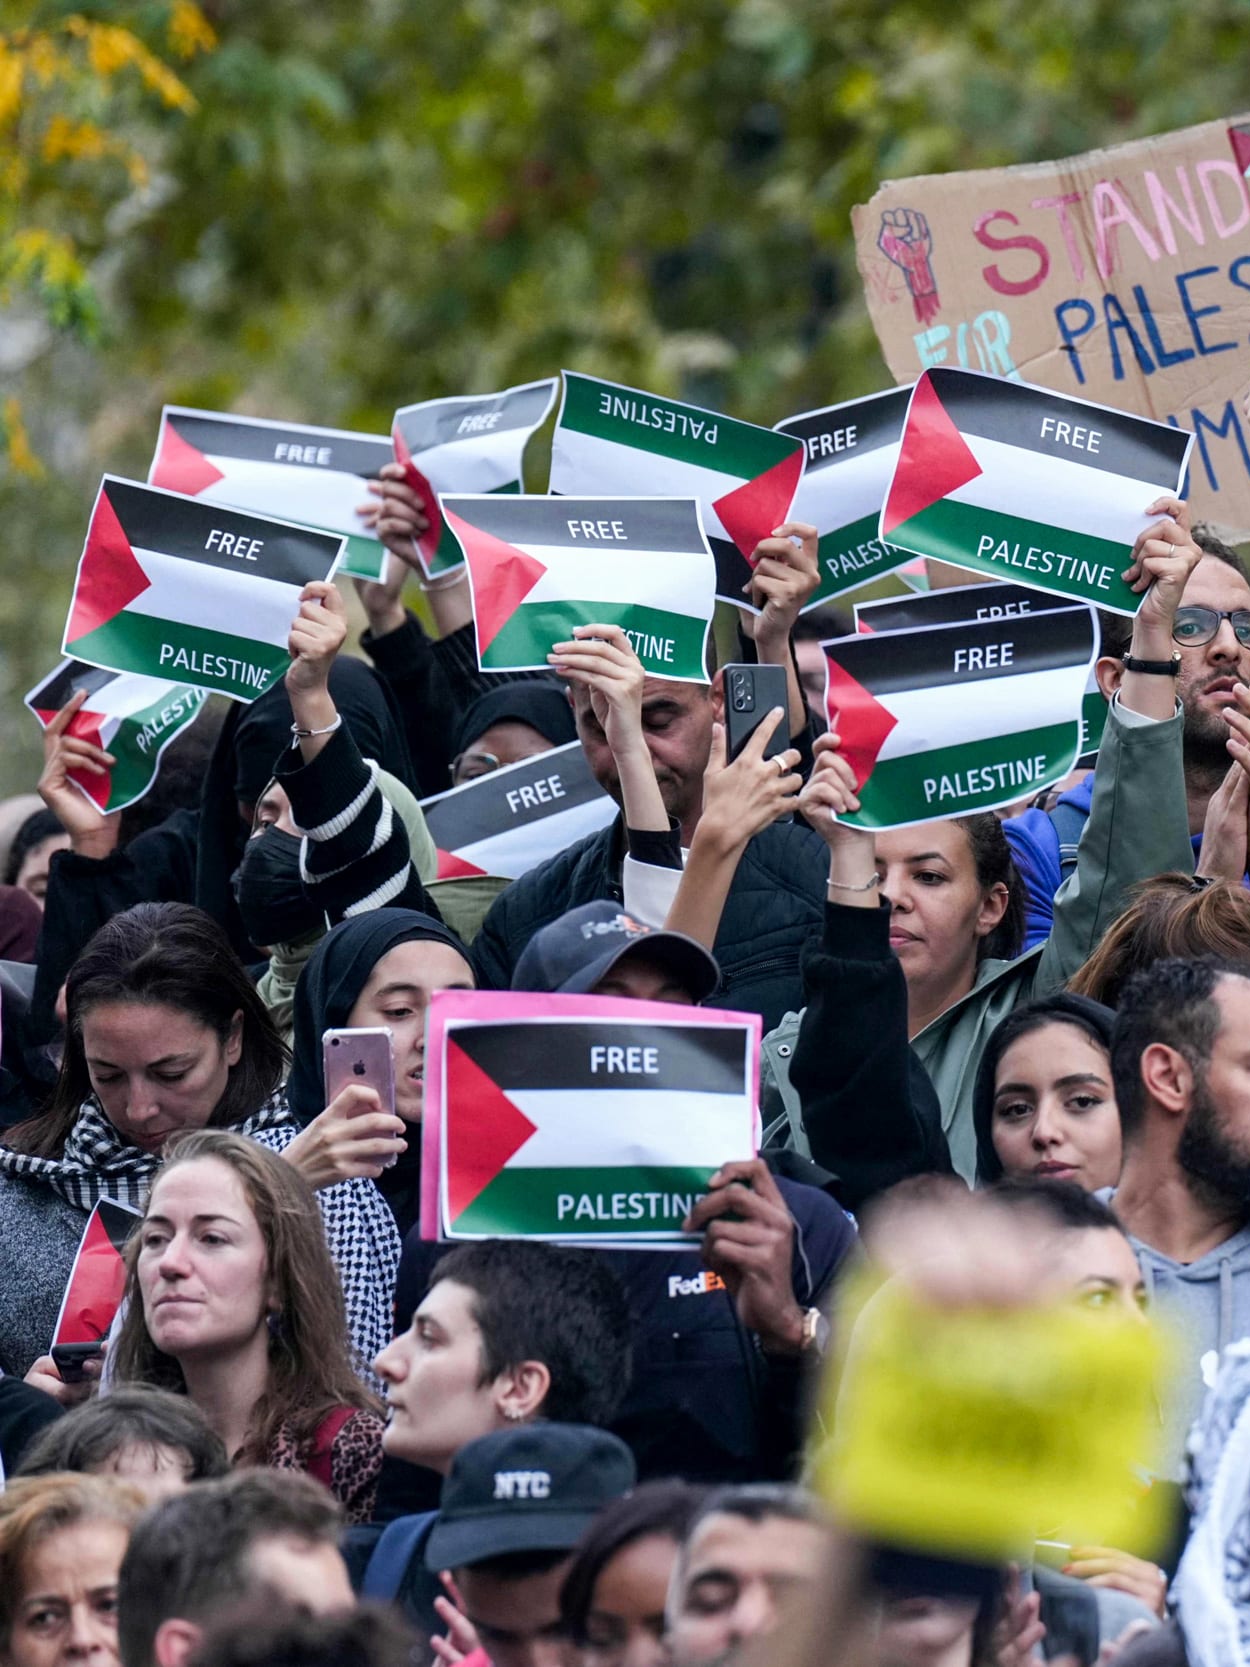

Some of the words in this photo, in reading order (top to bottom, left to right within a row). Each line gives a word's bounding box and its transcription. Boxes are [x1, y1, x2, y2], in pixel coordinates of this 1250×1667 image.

[455, 411, 503, 435] FREE
[599, 392, 718, 445] PALESTINE
[1039, 417, 1102, 453] FREE
[274, 443, 332, 465] FREE
[807, 425, 857, 459] FREE
[204, 529, 264, 561] FREE
[566, 519, 627, 541] FREE
[826, 537, 898, 579] PALEST
[976, 535, 1115, 590] PALESTINE
[159, 643, 271, 690] PALESTINE
[953, 643, 1013, 673] FREE
[506, 775, 567, 814] FREE
[922, 756, 1047, 804] PALESTINE
[590, 1046, 660, 1074] FREE
[494, 1472, 552, 1500] NYC
